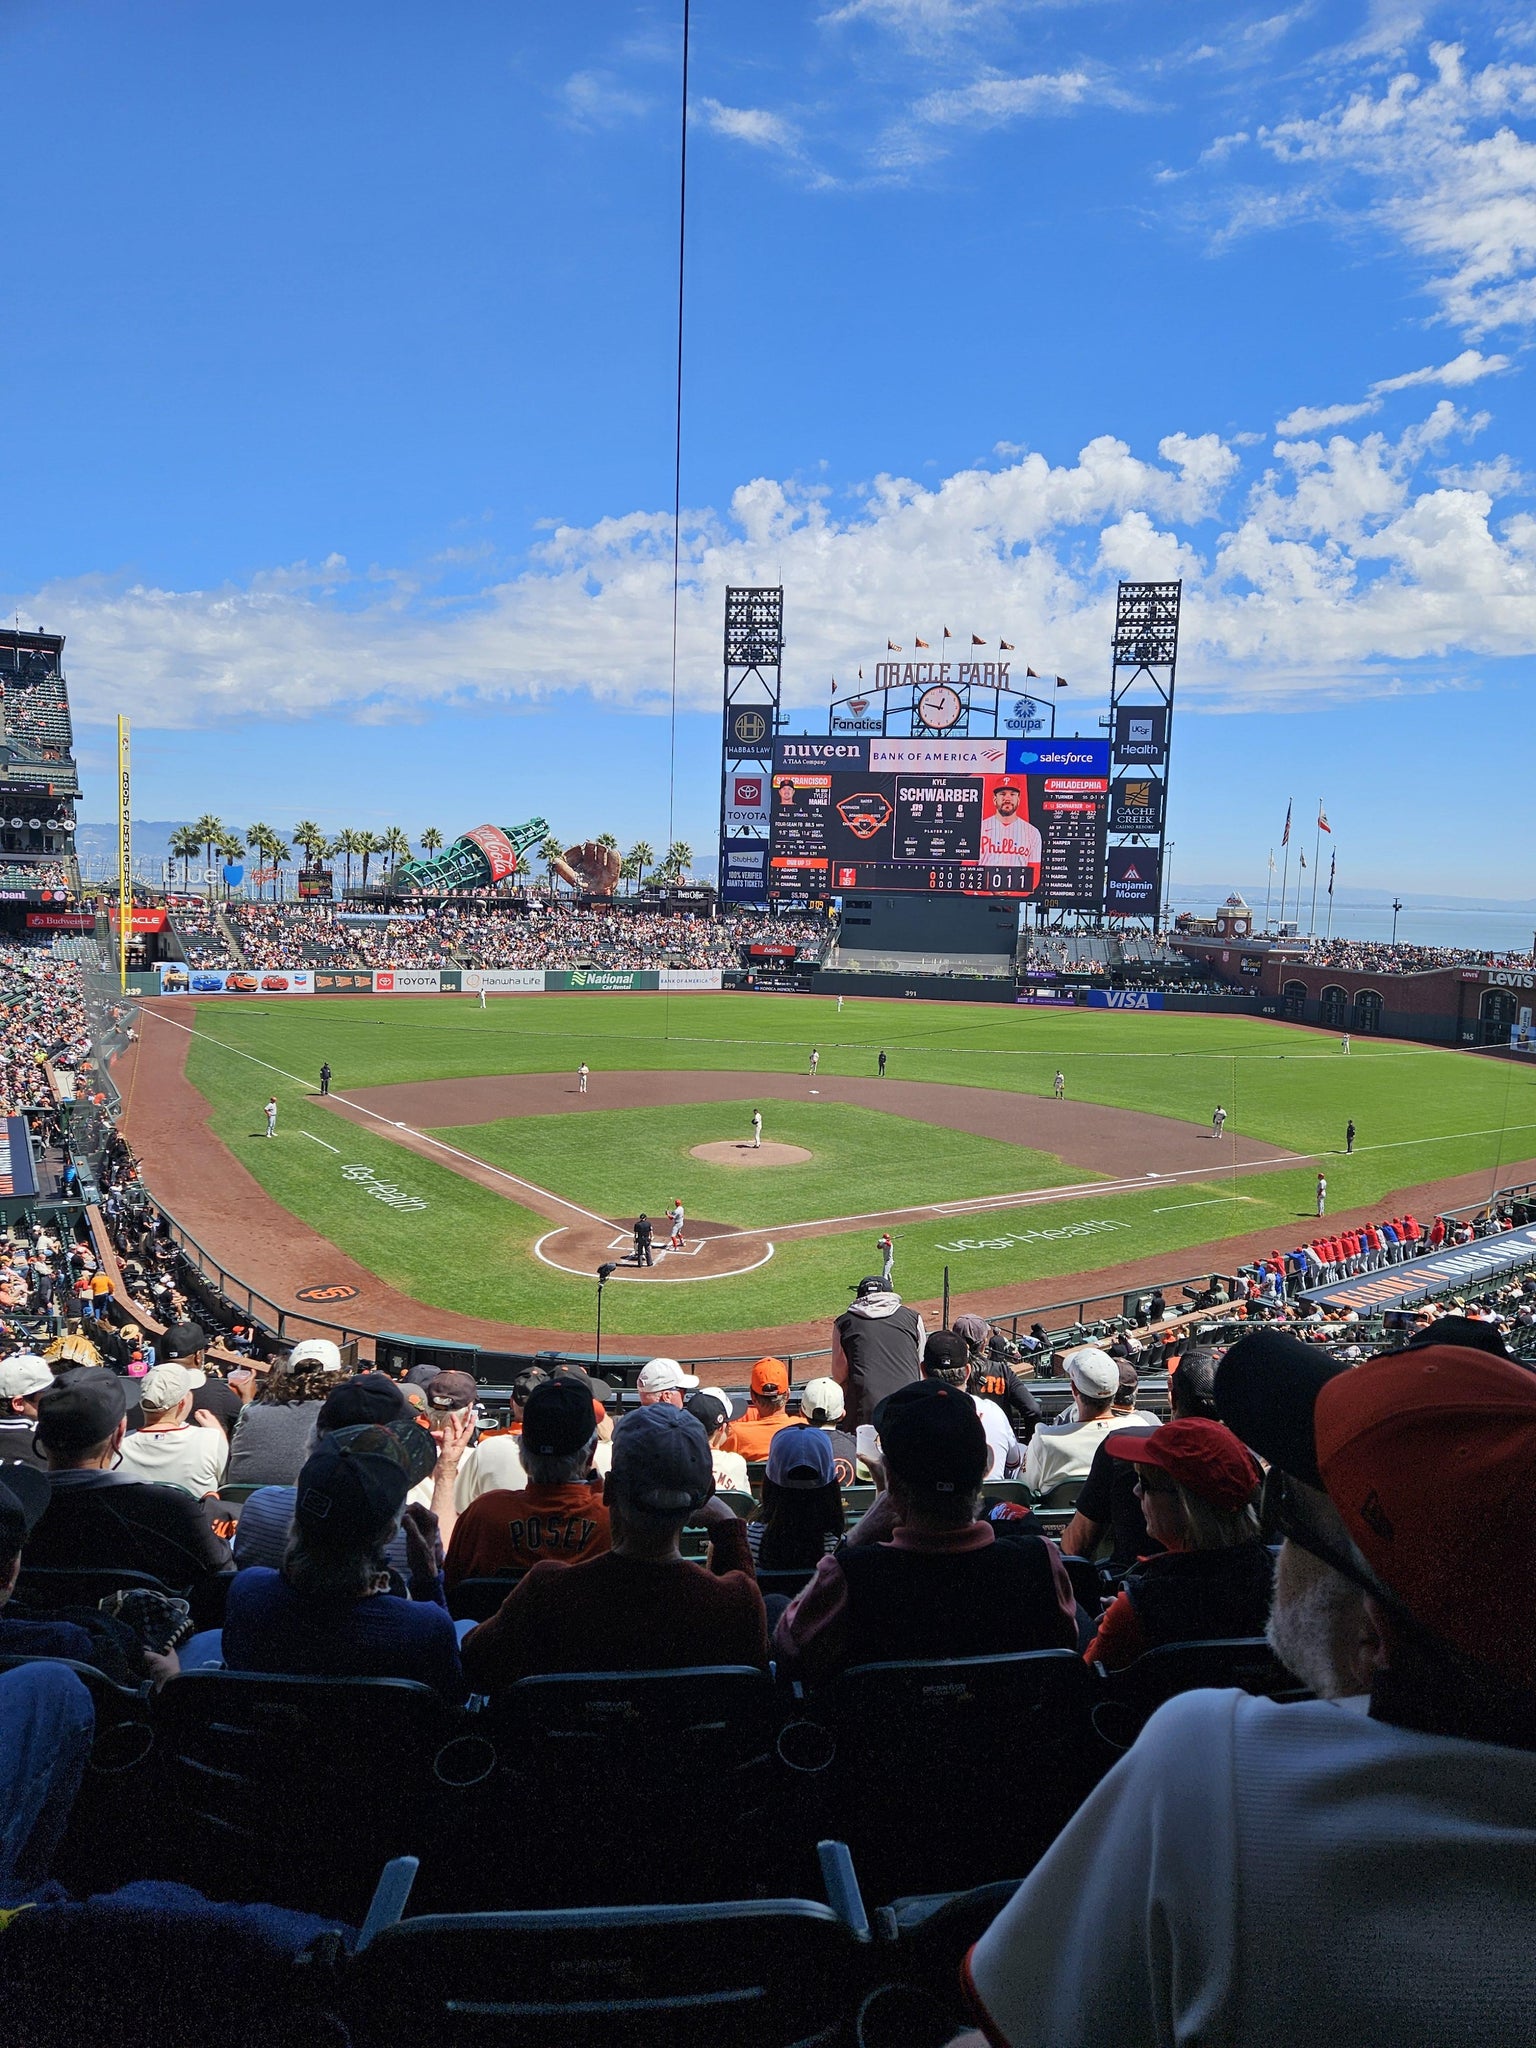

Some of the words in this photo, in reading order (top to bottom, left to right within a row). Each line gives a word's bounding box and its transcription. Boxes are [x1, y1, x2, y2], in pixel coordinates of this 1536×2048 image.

[876, 662, 951, 690] ORACLE
[959, 662, 1010, 690] PARK
[833, 718, 882, 731] Fanatics
[1007, 719, 1041, 732] coupa
[783, 744, 861, 758] nuveen
[1120, 744, 1158, 755] Health
[873, 752, 904, 760] BANK
[925, 753, 977, 761] AMERICA
[1040, 752, 1093, 765] salesforce
[1051, 780, 1101, 789] PHILADELPHIA
[899, 788, 979, 802] SCHWARBER
[728, 811, 767, 820] TOYOTA
[1116, 807, 1155, 816] CACHE
[1117, 816, 1153, 824] CREEK
[982, 836, 1031, 857] Phillies
[732, 855, 759, 864] StubHub
[162, 861, 217, 885] blue
[728, 871, 741, 879] 100%
[742, 871, 762, 880] VERIFIED
[744, 880, 764, 888] TICKETS
[993, 874, 1001, 888] 0
[1006, 874, 1012, 888] 1
[1020, 874, 1024, 888] 1
[1110, 880, 1153, 891] Benjamin
[1115, 890, 1146, 899] Moore
[46, 916, 91, 925] Budweiser
[398, 977, 437, 986] TOYOTA
[482, 977, 520, 985] Hanwha
[523, 977, 541, 985] Life
[586, 973, 634, 984] National
[1102, 992, 1149, 1008] VISA
[1262, 1006, 1276, 1014] 415
[356, 1180, 430, 1212] Health
[1006, 1220, 1132, 1244] Health
[1427, 1252, 1507, 1275] ORACLE
[1481, 1240, 1536, 1257] PARK
[1323, 1276, 1428, 1308] WELCOME
[1403, 1268, 1450, 1283] TO
[509, 1516, 597, 1553] POSEY
